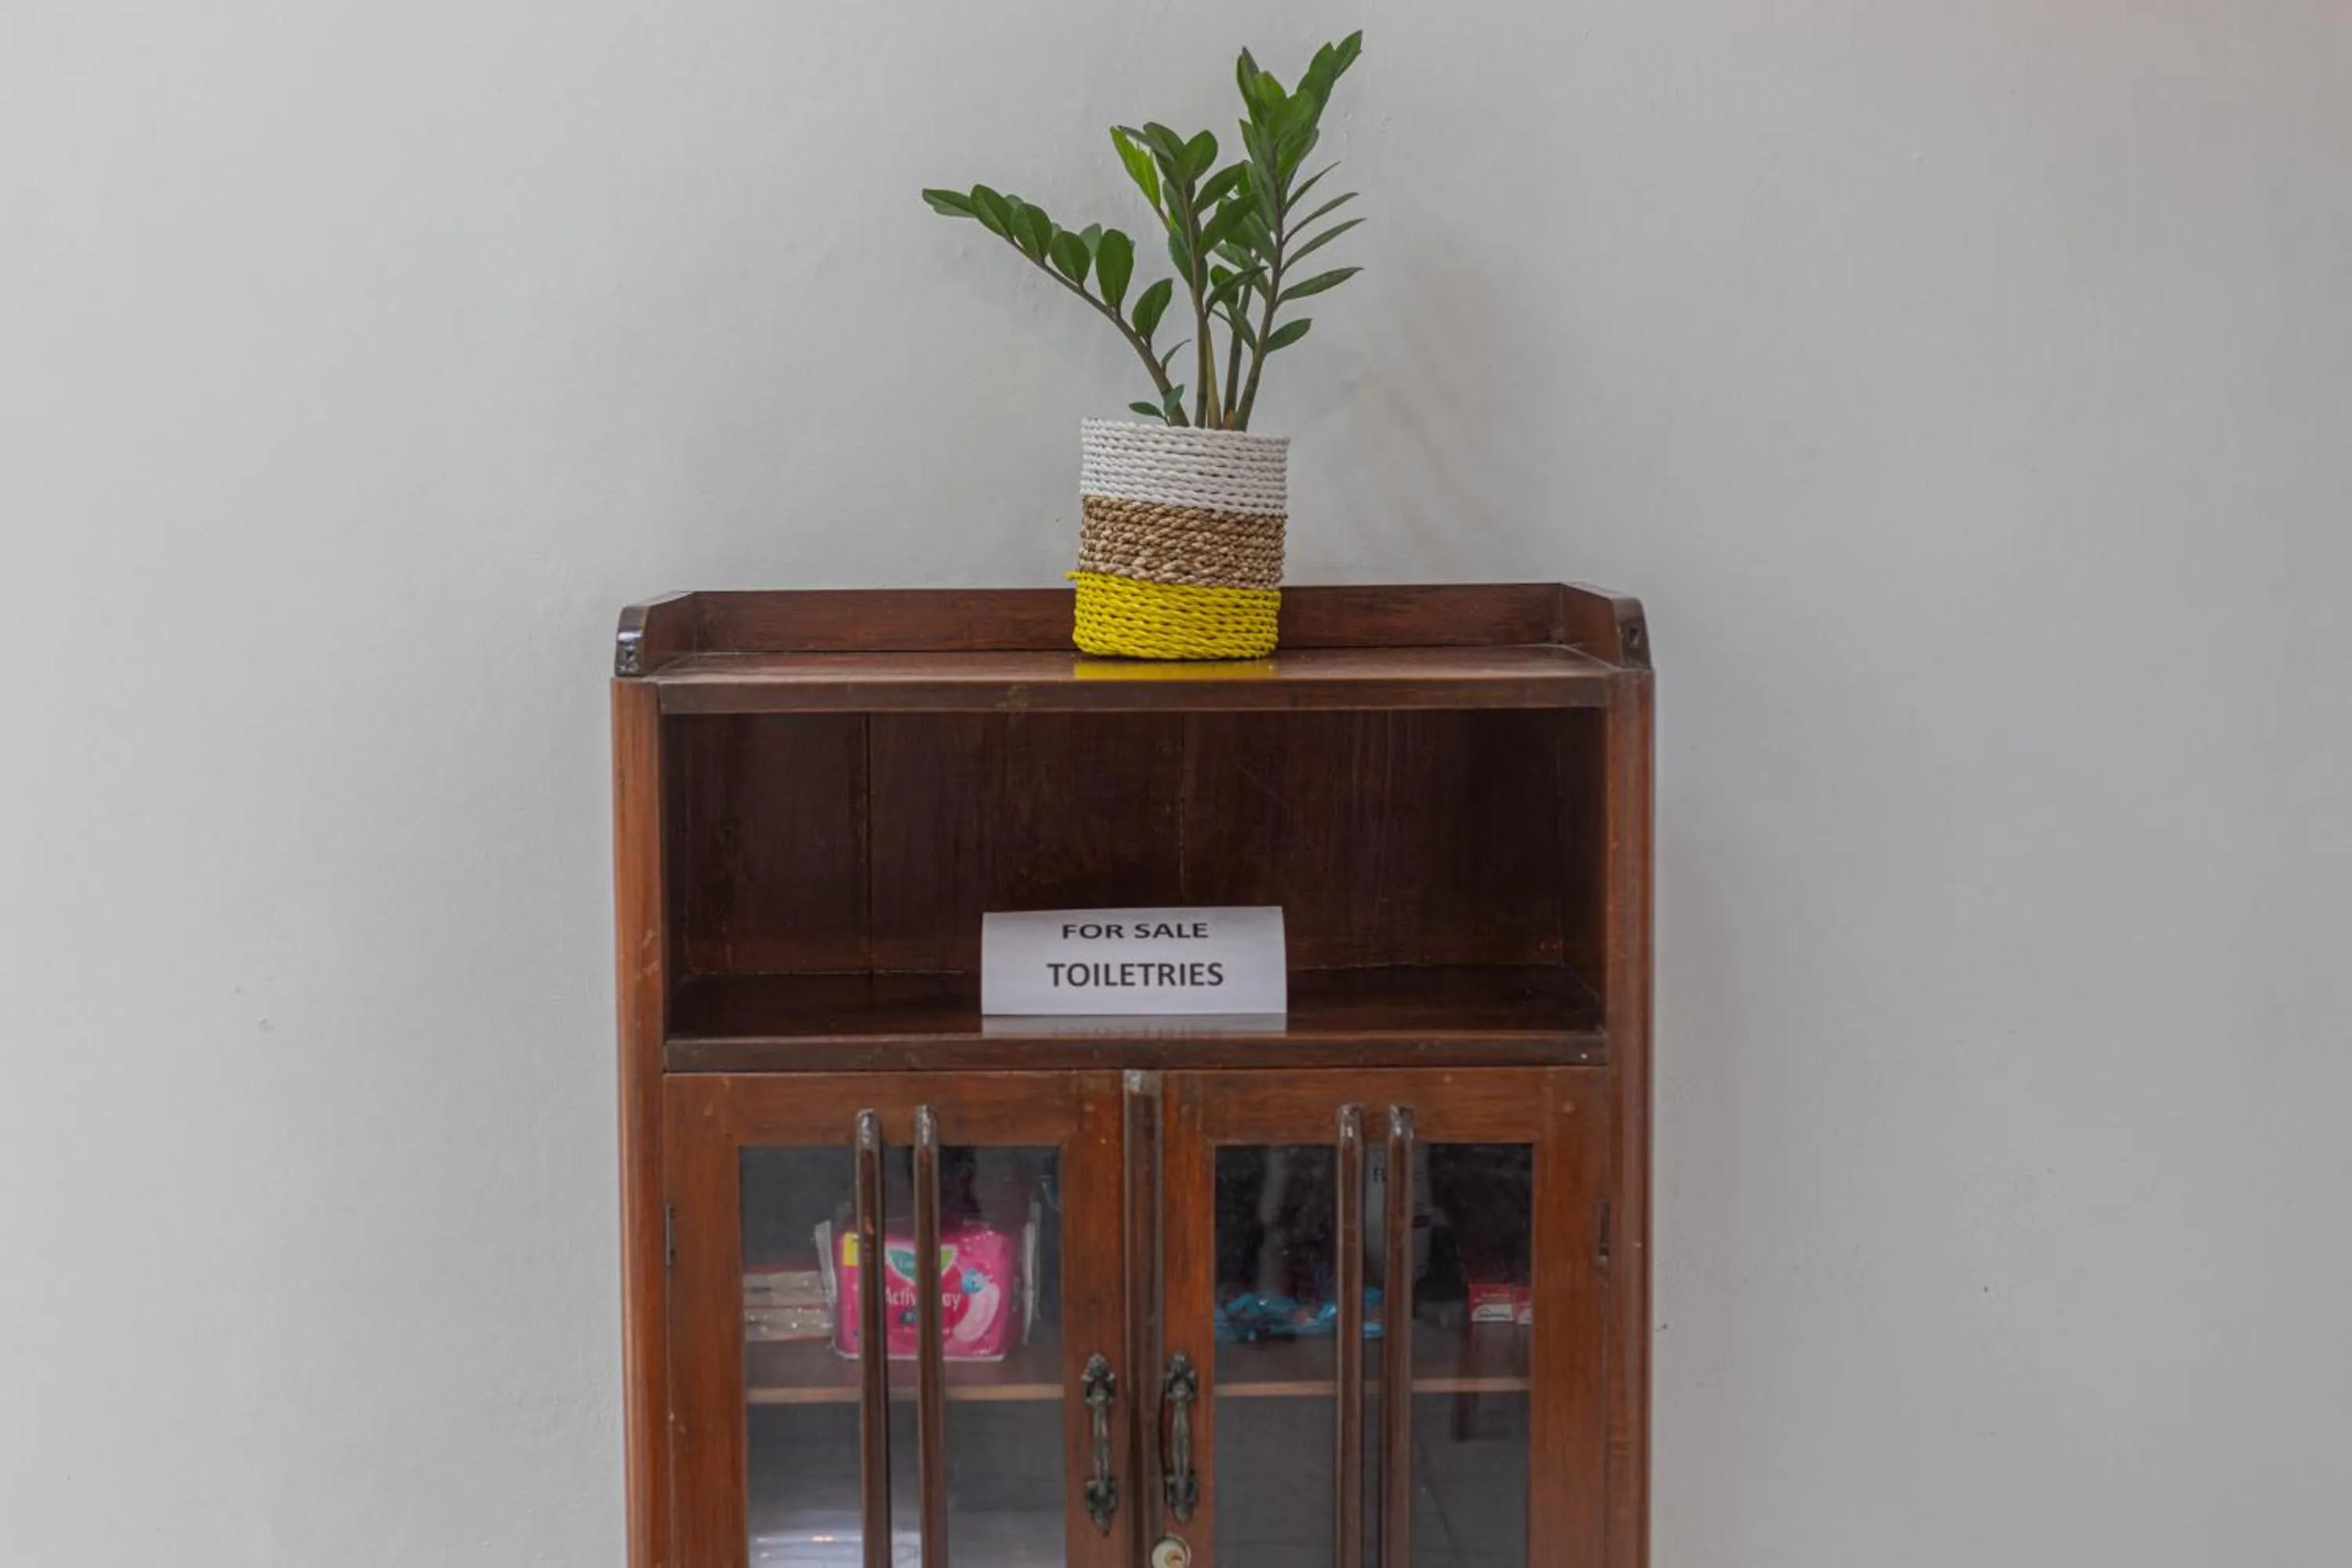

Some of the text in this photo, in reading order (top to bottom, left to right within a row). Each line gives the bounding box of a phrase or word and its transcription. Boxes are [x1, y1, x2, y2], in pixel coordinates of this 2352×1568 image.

[1062, 922, 1209, 940] FOR SALE
[1046, 962, 1224, 987] TOILETRIES
[885, 1286, 960, 1312] Activ ay
